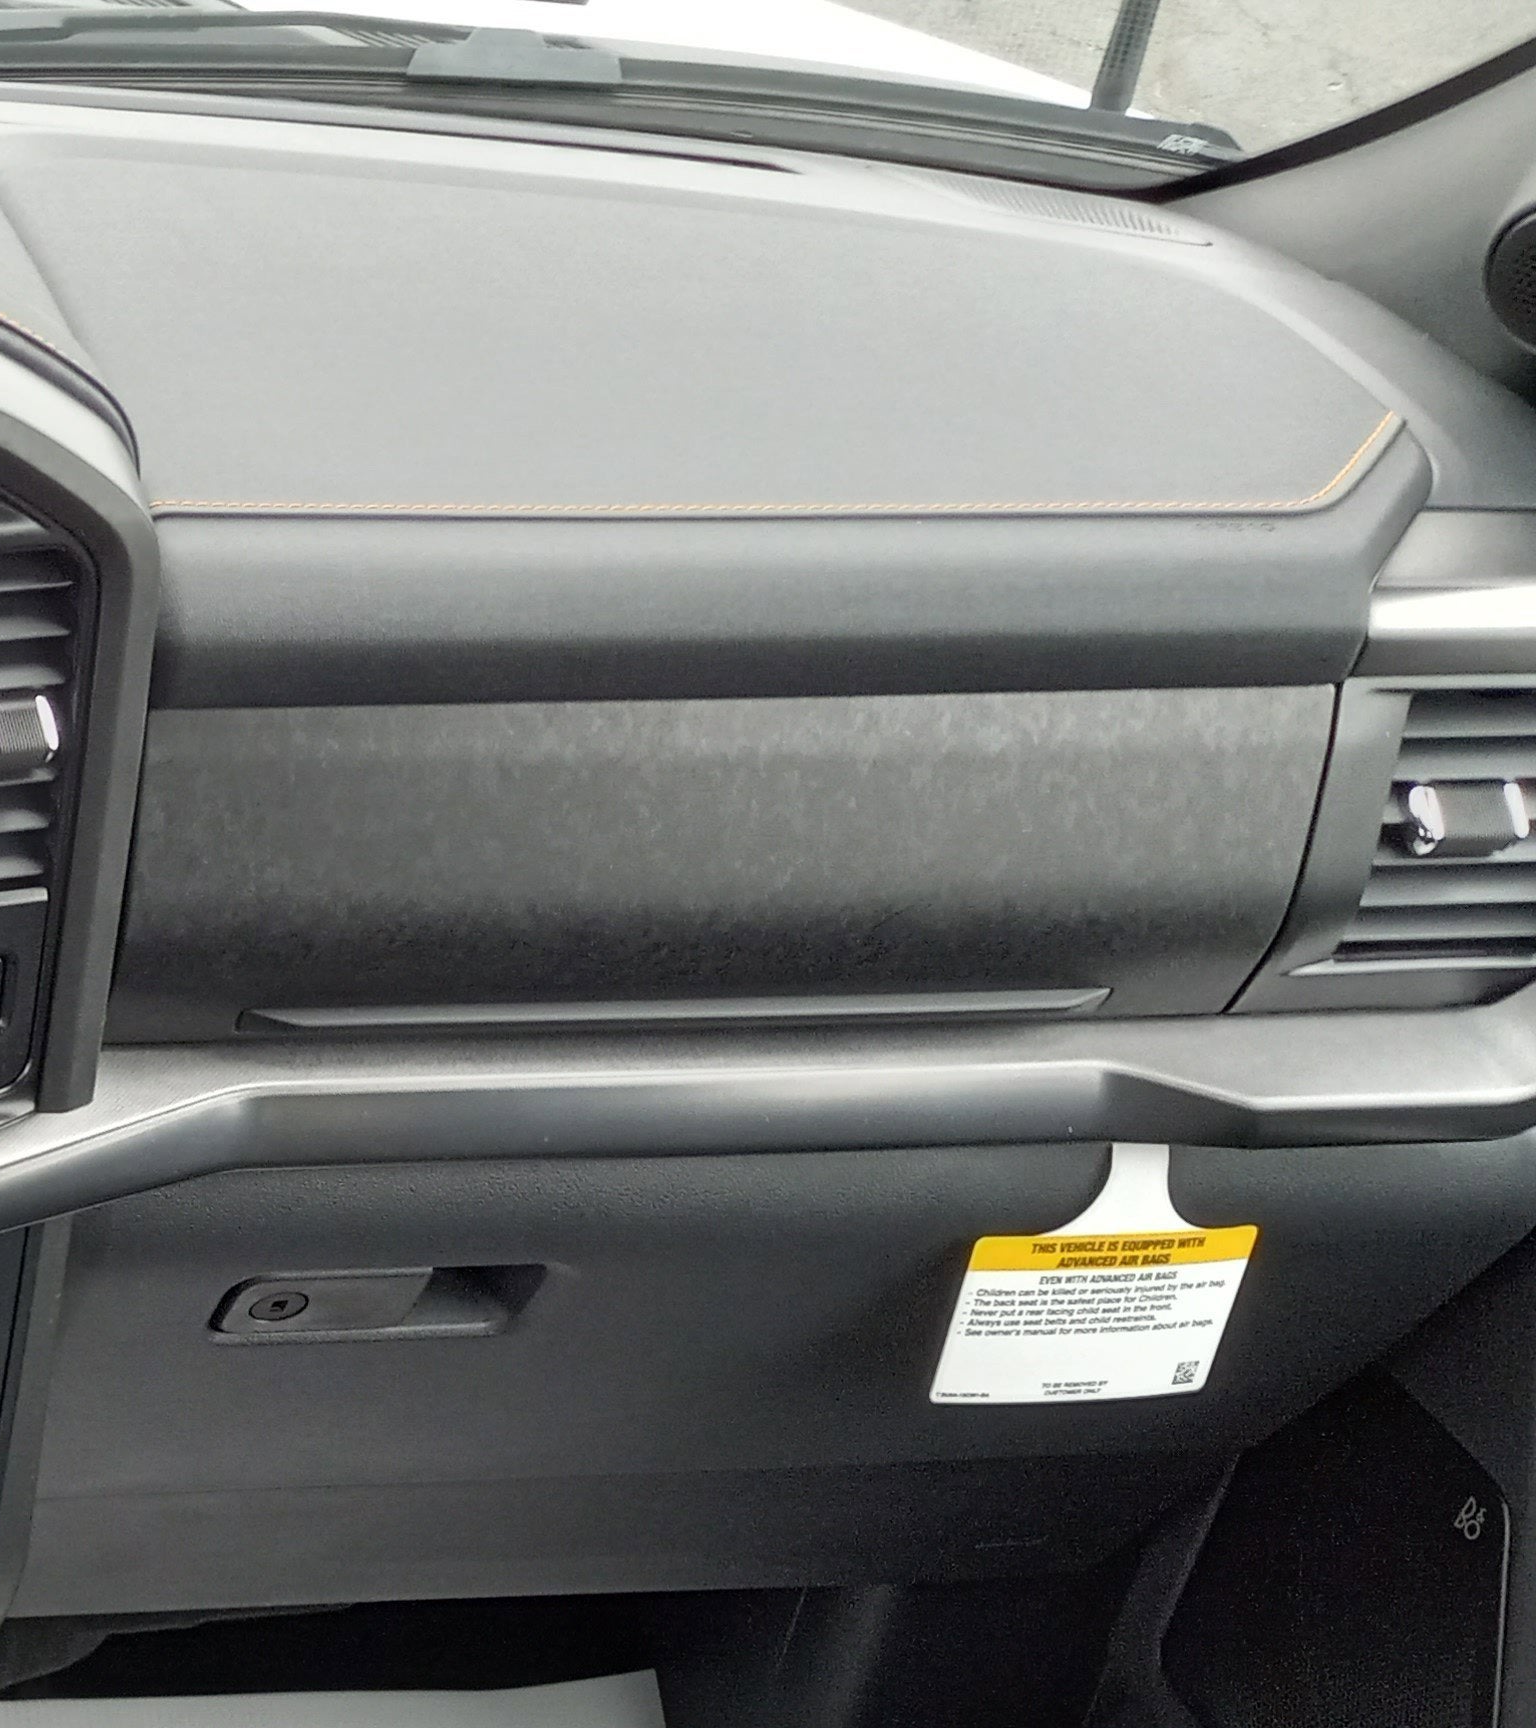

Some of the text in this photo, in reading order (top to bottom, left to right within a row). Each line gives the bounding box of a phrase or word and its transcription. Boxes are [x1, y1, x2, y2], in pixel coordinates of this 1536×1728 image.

[1031, 1236, 1206, 1255] THIS VEHICLE IS EQUIPPED WITH
[1056, 1253, 1172, 1268] ADVANCED AIR BAGS
[1089, 1273, 1136, 1284] ADVANCED
[1138, 1272, 1153, 1282] AIR
[1154, 1270, 1179, 1281] BAGS
[974, 1298, 991, 1307] The
[993, 1297, 1016, 1306] back
[1018, 1298, 1038, 1306] seat
[1050, 1297, 1065, 1305] the
[1067, 1296, 1096, 1305] safest
[1097, 1296, 1122, 1306] place
[1123, 1295, 1137, 1303] for
[970, 1308, 999, 1317] Never
[999, 1308, 1016, 1318] put
[1046, 1308, 1074, 1317] facing
[1076, 1307, 1100, 1315] child
[1101, 1306, 1121, 1314] seat
[1133, 1304, 1148, 1312] the
[965, 1328, 983, 1337] See
[984, 1328, 1020, 1336] owner's
[1022, 1327, 1056, 1336] manual
[1058, 1327, 1072, 1335] for
[1098, 1324, 1150, 1333] information
[1151, 1321, 1177, 1331] about
[967, 1318, 1001, 1328] Always
[1023, 1318, 1043, 1326] seat
[1045, 1318, 1066, 1326] belts
[1068, 1317, 1087, 1325] and
[1088, 1316, 1111, 1324] child
